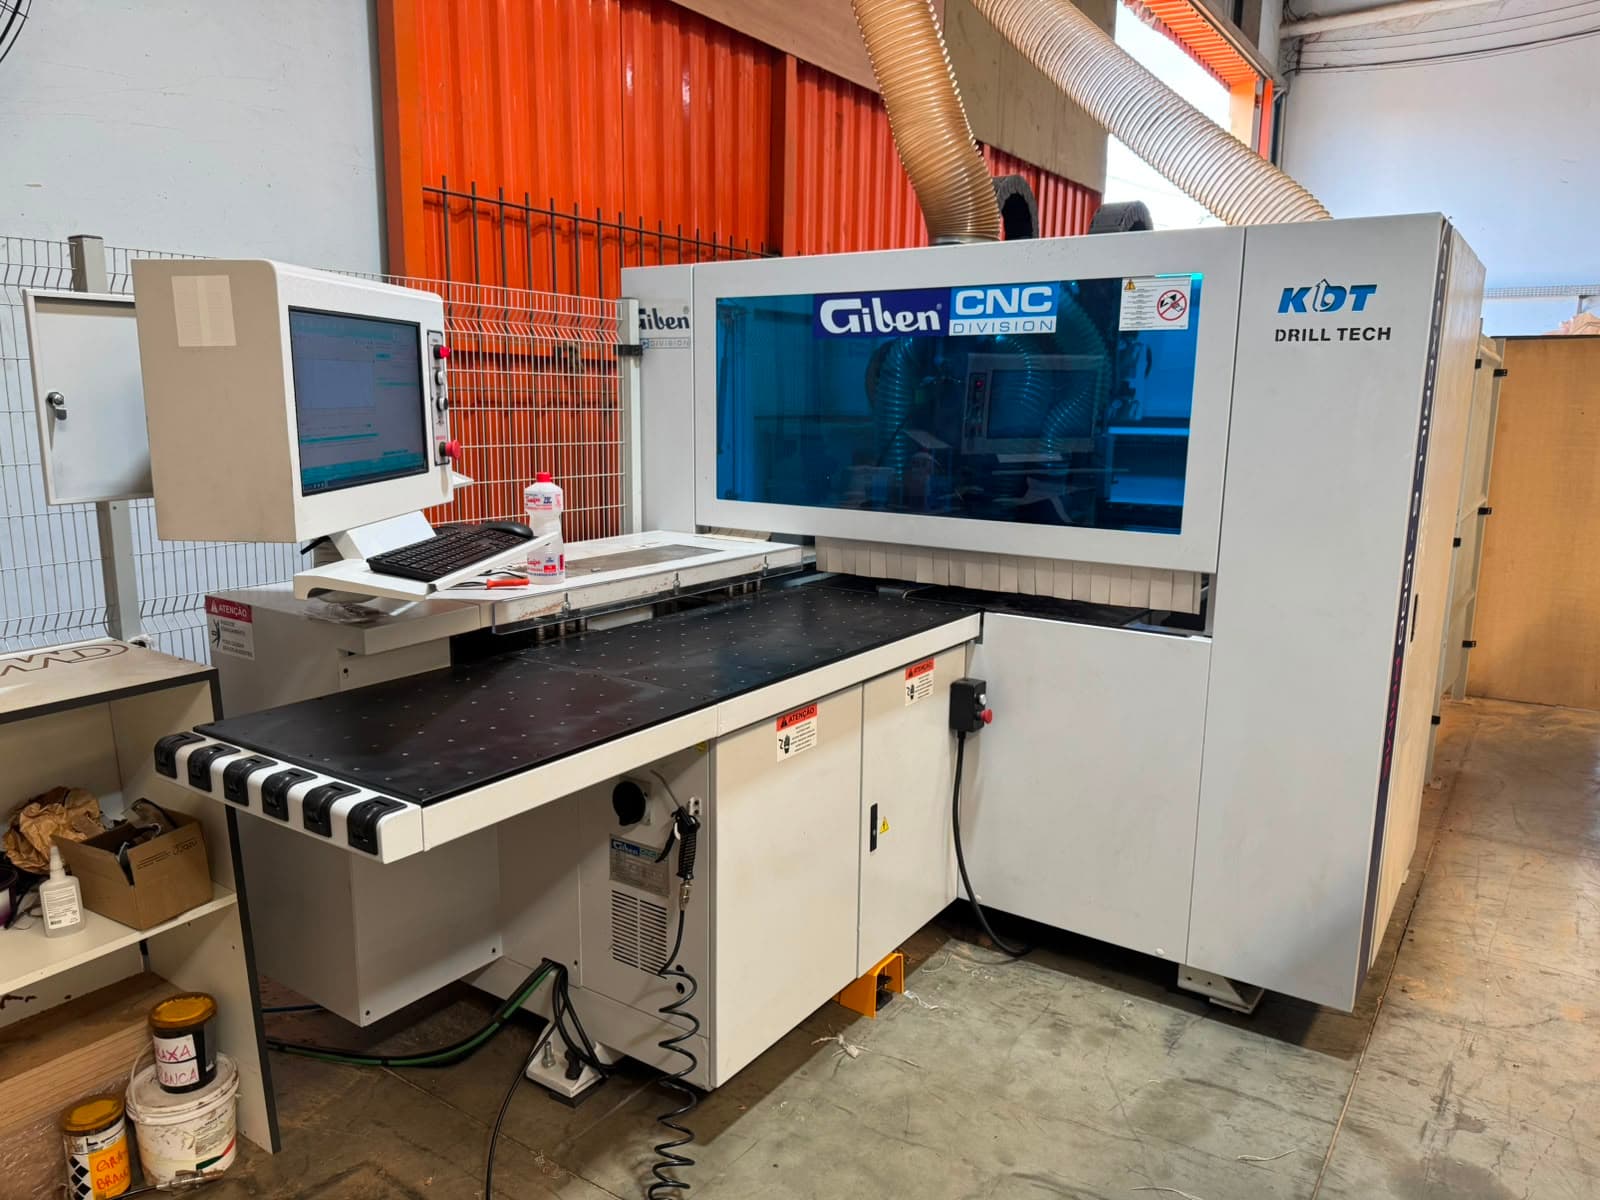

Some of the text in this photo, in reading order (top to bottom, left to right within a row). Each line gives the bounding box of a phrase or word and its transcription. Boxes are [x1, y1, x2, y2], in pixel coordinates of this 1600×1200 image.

[955, 286, 1053, 316] CNC
[1277, 279, 1378, 313] KDT
[819, 297, 942, 335] Giben
[952, 319, 1054, 334] DIVISION
[1274, 326, 1392, 342] DRILL TECH
